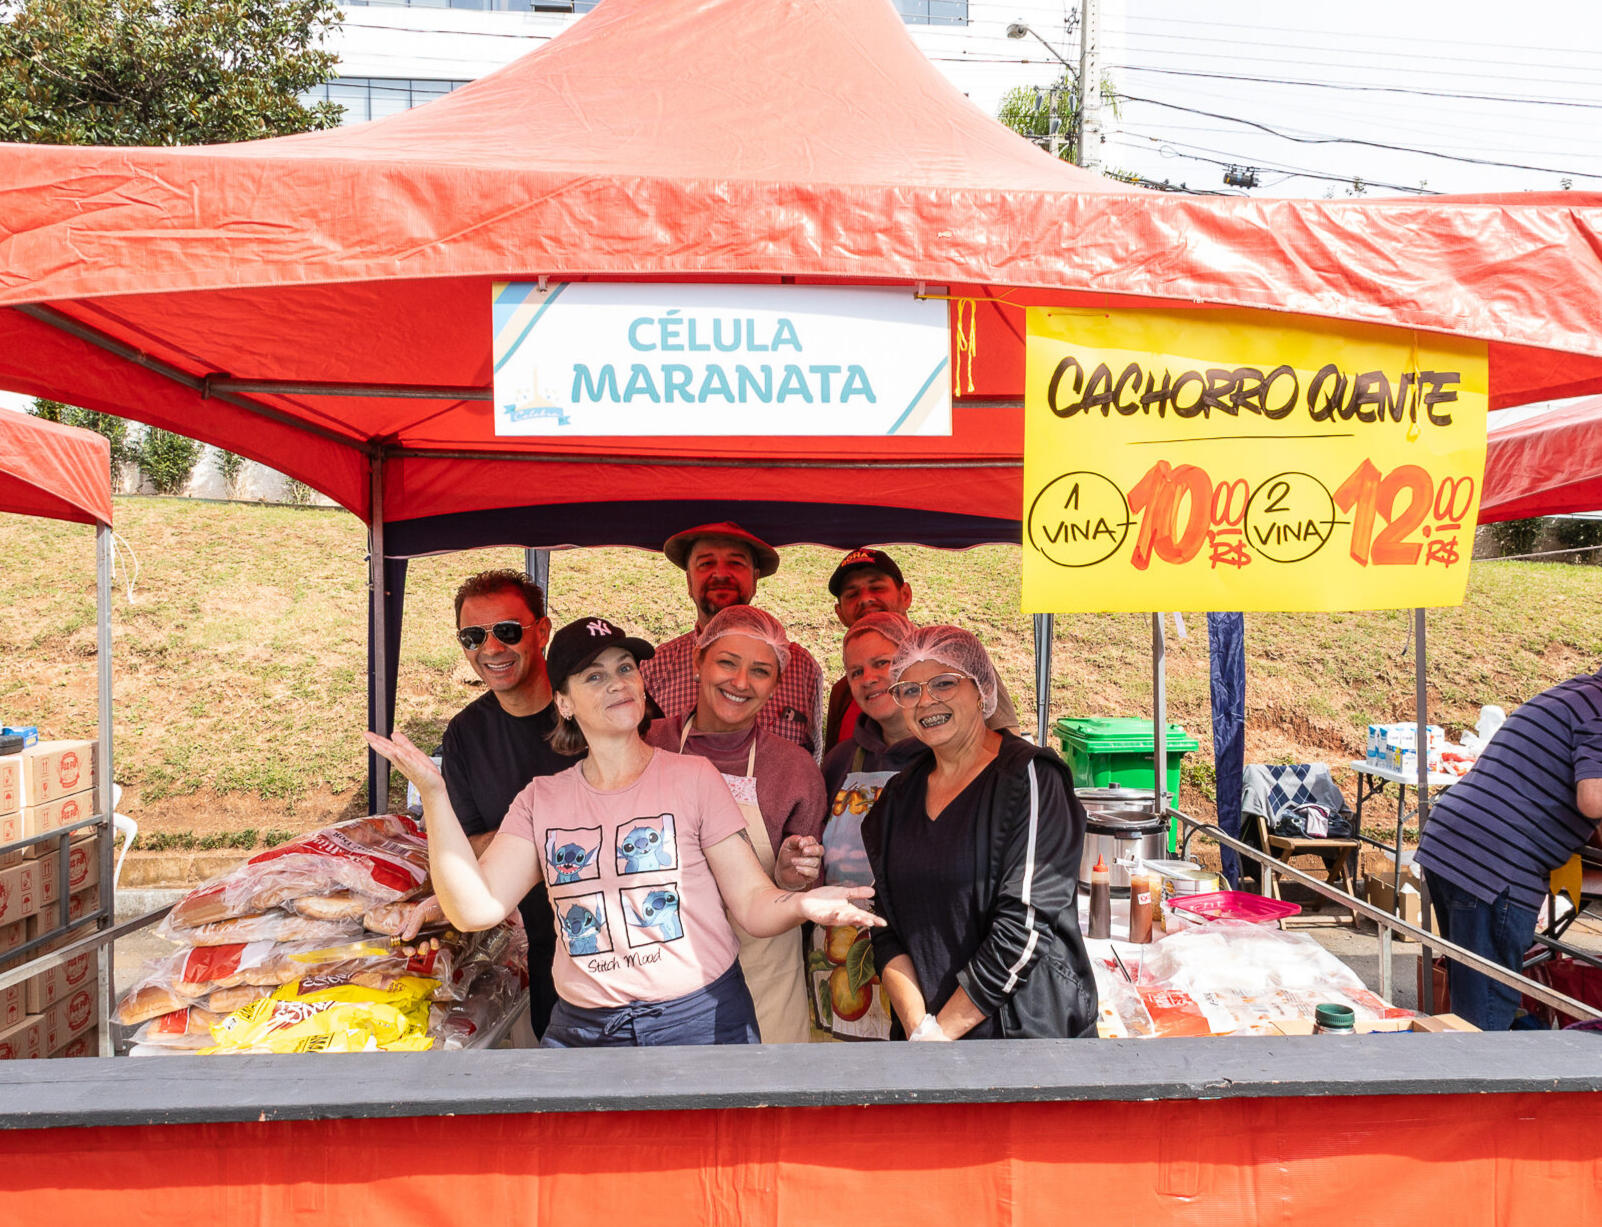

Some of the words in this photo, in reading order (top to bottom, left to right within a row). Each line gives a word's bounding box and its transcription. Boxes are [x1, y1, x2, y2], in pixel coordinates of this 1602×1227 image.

[627, 309, 803, 352] CÉLULA
[571, 363, 877, 404] MARANATA
[1047, 356, 1300, 420] CACHORRO
[1307, 363, 1462, 427] QUENTE
[1064, 482, 1080, 511] 1
[1264, 481, 1290, 513] 2
[1042, 517, 1117, 544] VINA
[1253, 519, 1324, 546] VINA
[586, 619, 612, 637] NY
[588, 956, 620, 973] Stitch
[623, 947, 662, 968] Mood
